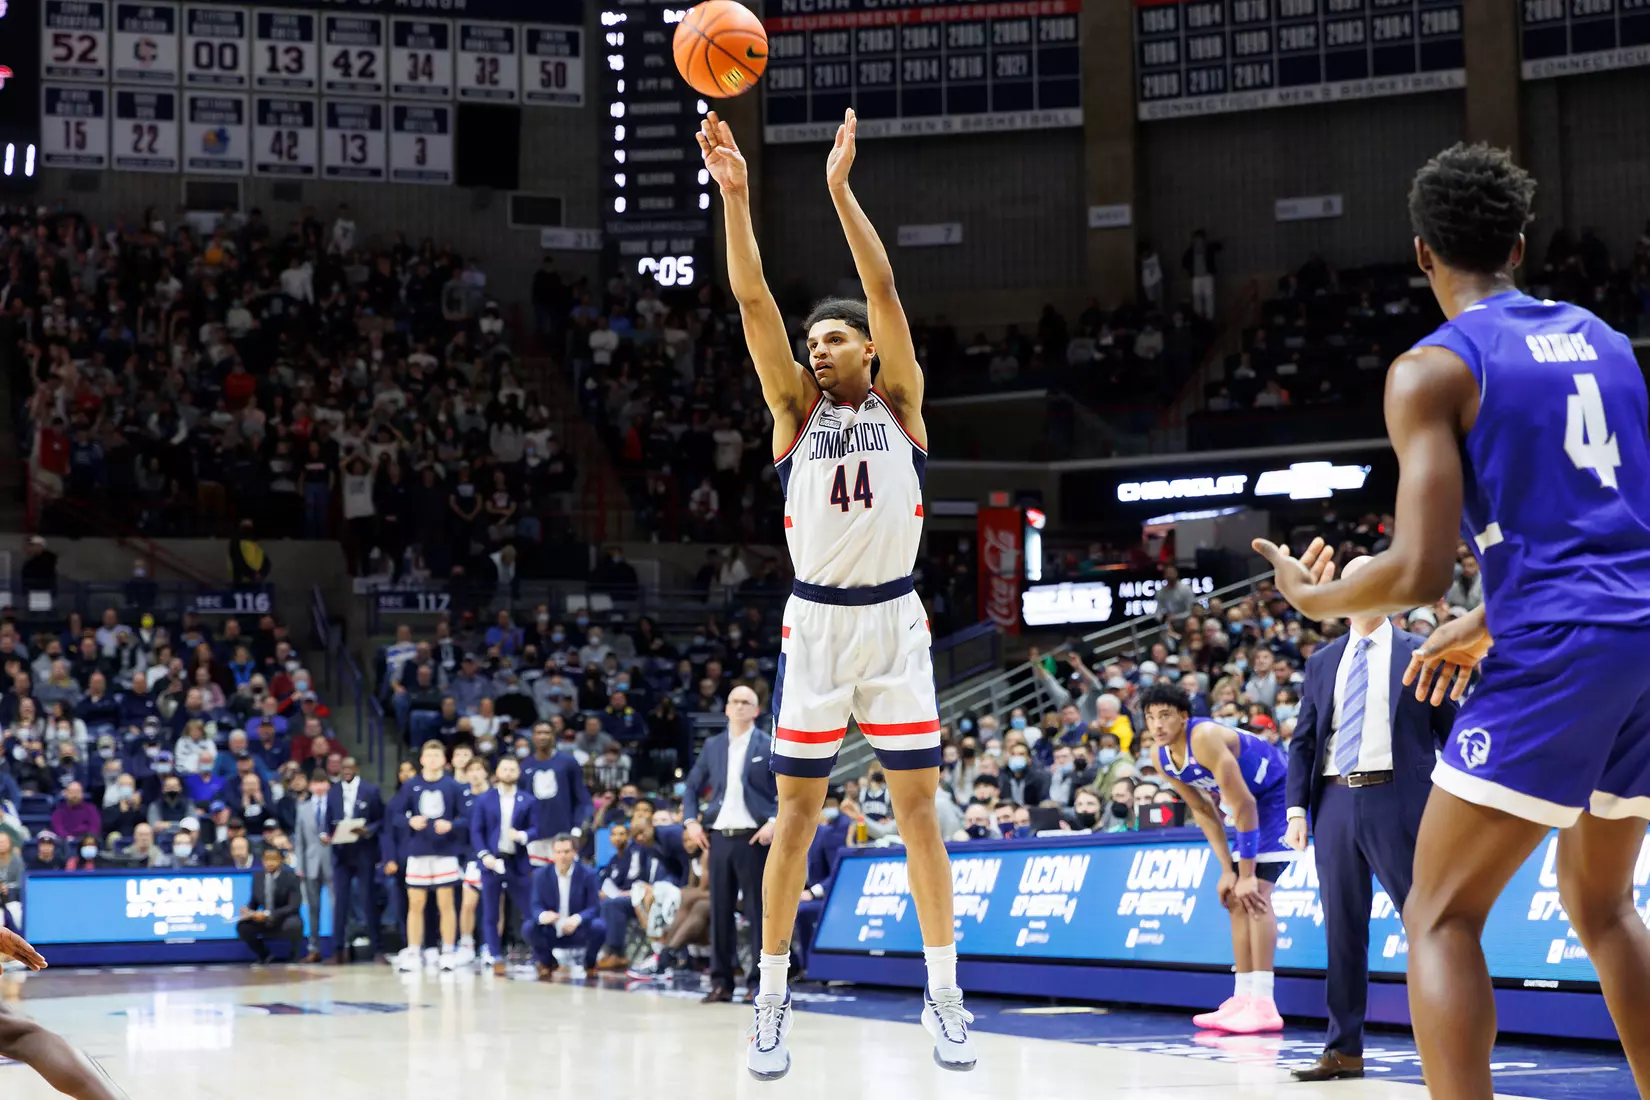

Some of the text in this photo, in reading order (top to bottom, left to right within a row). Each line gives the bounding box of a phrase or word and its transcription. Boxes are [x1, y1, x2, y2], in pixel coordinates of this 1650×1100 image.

[52, 33, 98, 63] 52
[193, 41, 239, 71] 00
[266, 44, 304, 74] 13
[331, 48, 376, 79] 42
[407, 52, 434, 82] 34
[474, 56, 500, 86] 32
[539, 60, 567, 89] 50
[1531, 50, 1649, 77] CONNECTICU
[64, 120, 87, 150] 15
[131, 123, 159, 154] 22
[270, 130, 299, 161] 42
[340, 133, 368, 164] 13
[415, 137, 426, 166] 3
[1563, 373, 1621, 491] 4
[829, 460, 873, 512] 44
[233, 592, 270, 612] 116
[417, 593, 451, 612] 117
[1018, 855, 1090, 894] UCONN
[1125, 849, 1210, 891] UCONN
